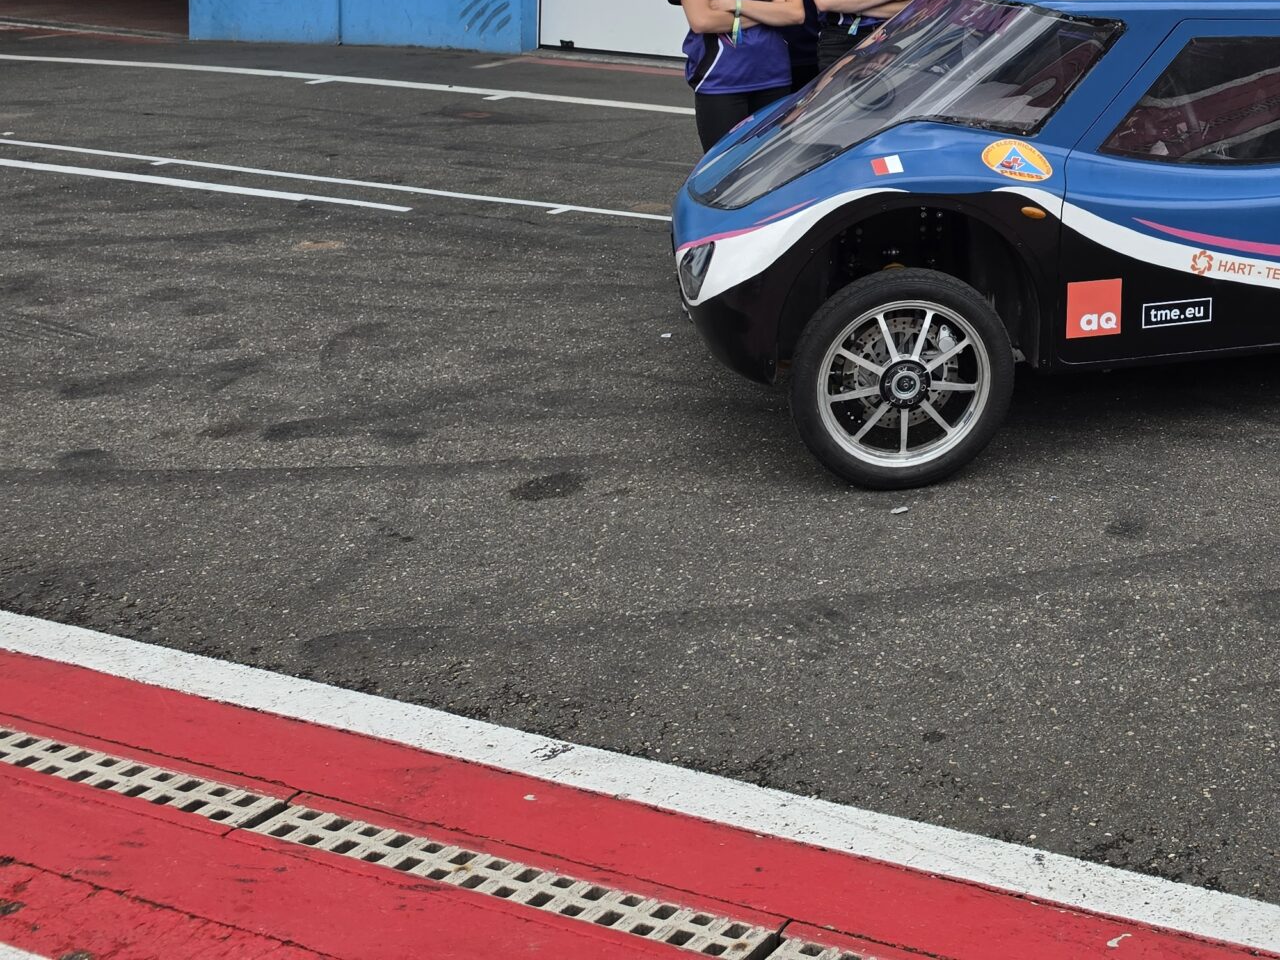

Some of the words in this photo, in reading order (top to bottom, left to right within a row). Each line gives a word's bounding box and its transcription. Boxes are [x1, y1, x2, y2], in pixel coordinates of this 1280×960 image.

[1001, 169, 1043, 180] PRESS
[1217, 259, 1256, 276] HART
[1150, 305, 1204, 322] tme.eu
